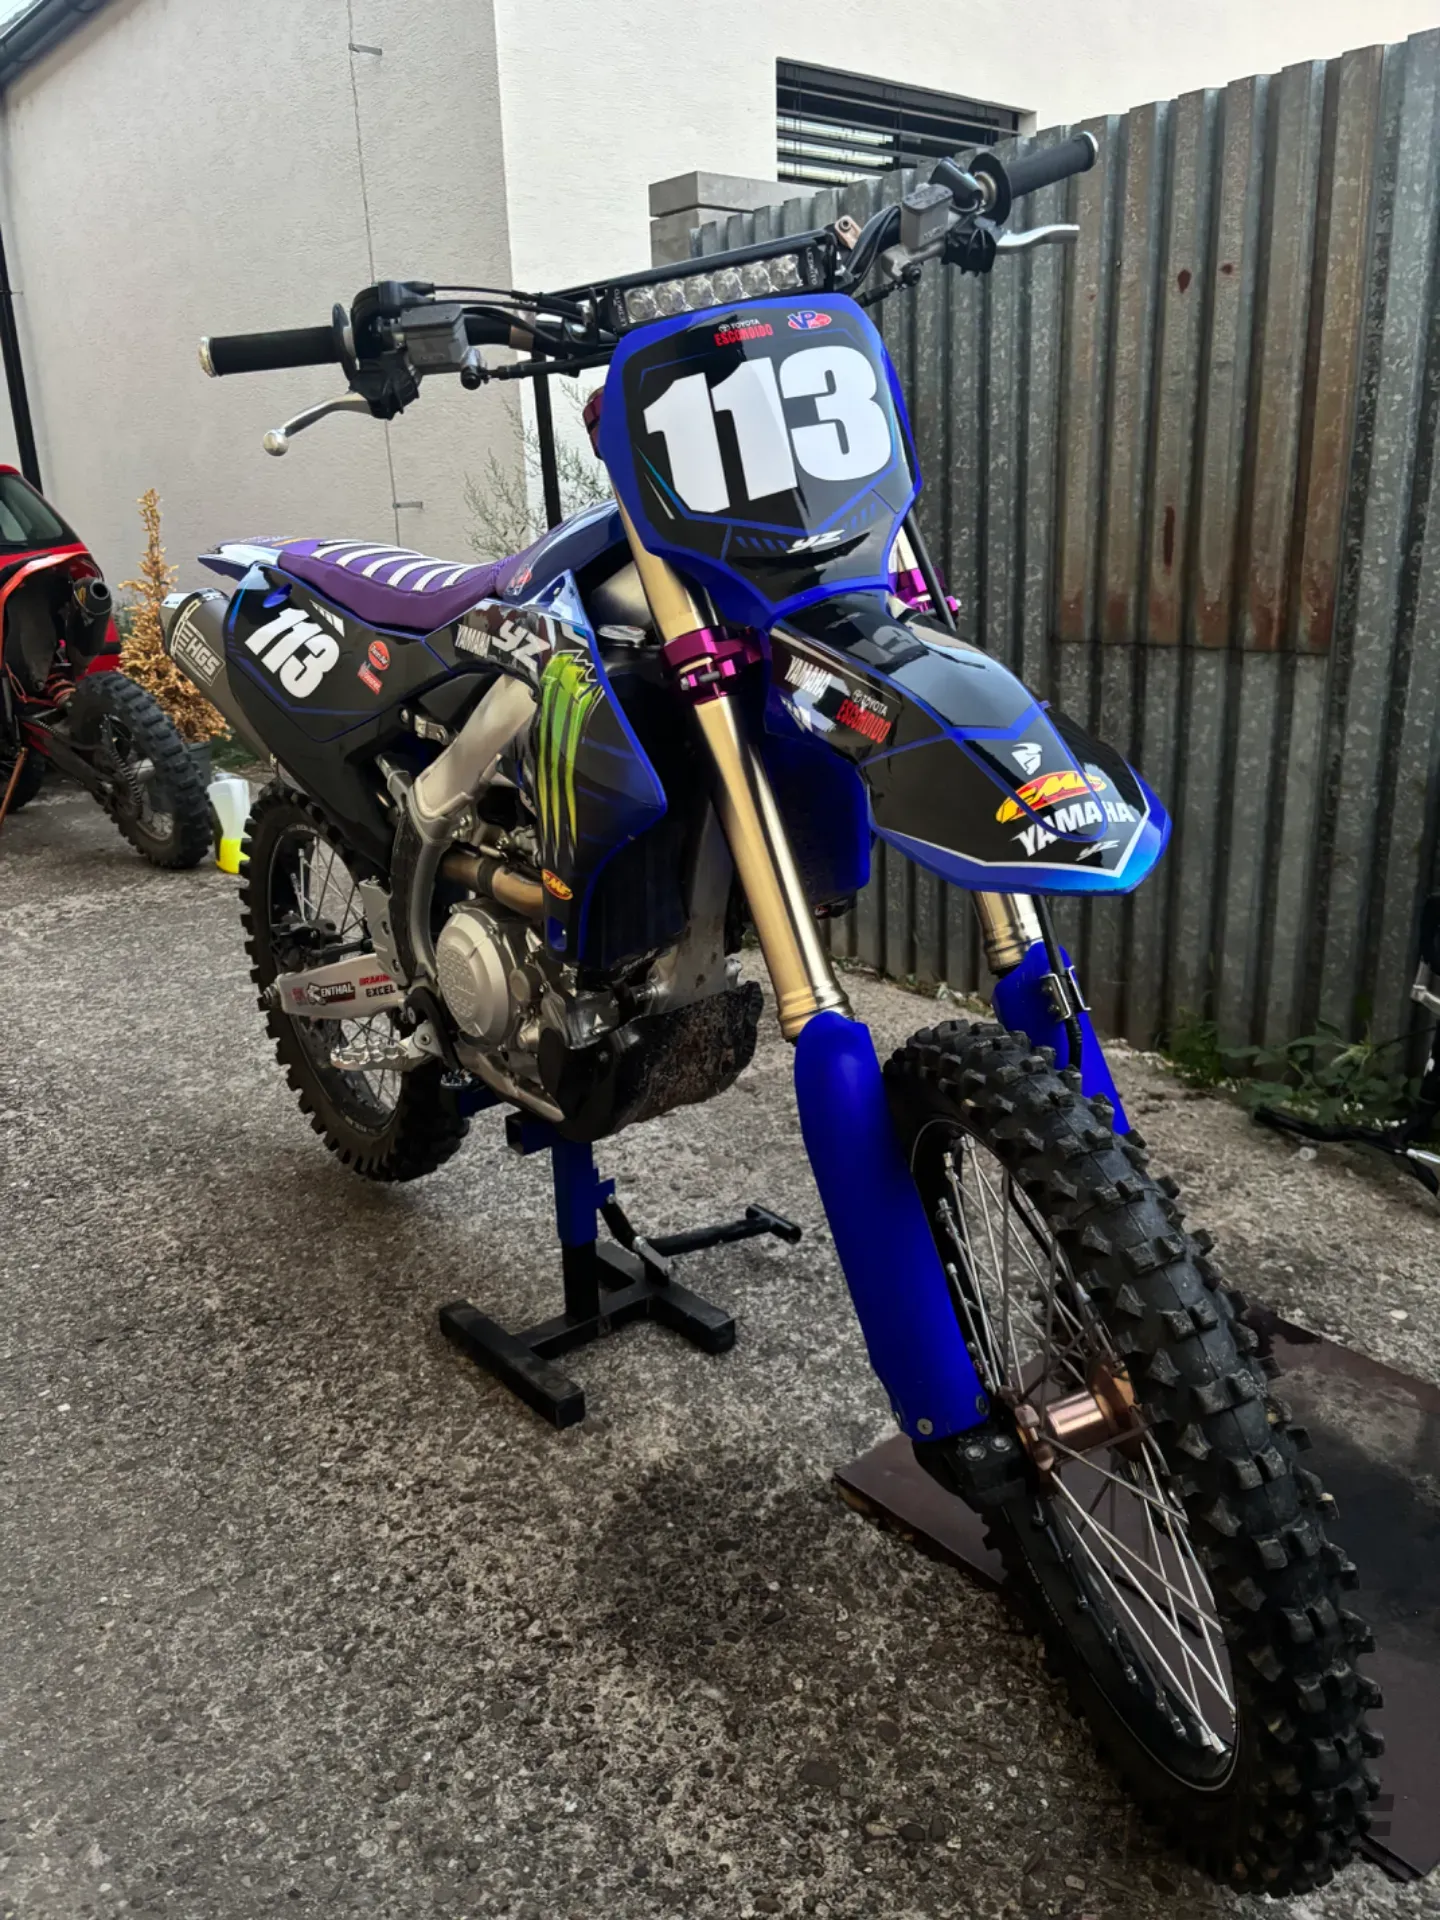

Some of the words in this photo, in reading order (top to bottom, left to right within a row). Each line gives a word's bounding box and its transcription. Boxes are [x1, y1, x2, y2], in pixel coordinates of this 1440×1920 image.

[731, 319, 760, 330] TOYOTA
[643, 345, 892, 514] 113
[185, 637, 221, 677] HGS
[244, 607, 340, 699] 113
[491, 619, 551, 674] YZ
[784, 654, 834, 699] YAMAHA
[861, 694, 889, 717] TOYOTA
[1009, 800, 1137, 858] YAMAHA
[365, 984, 396, 998] EXCEL
